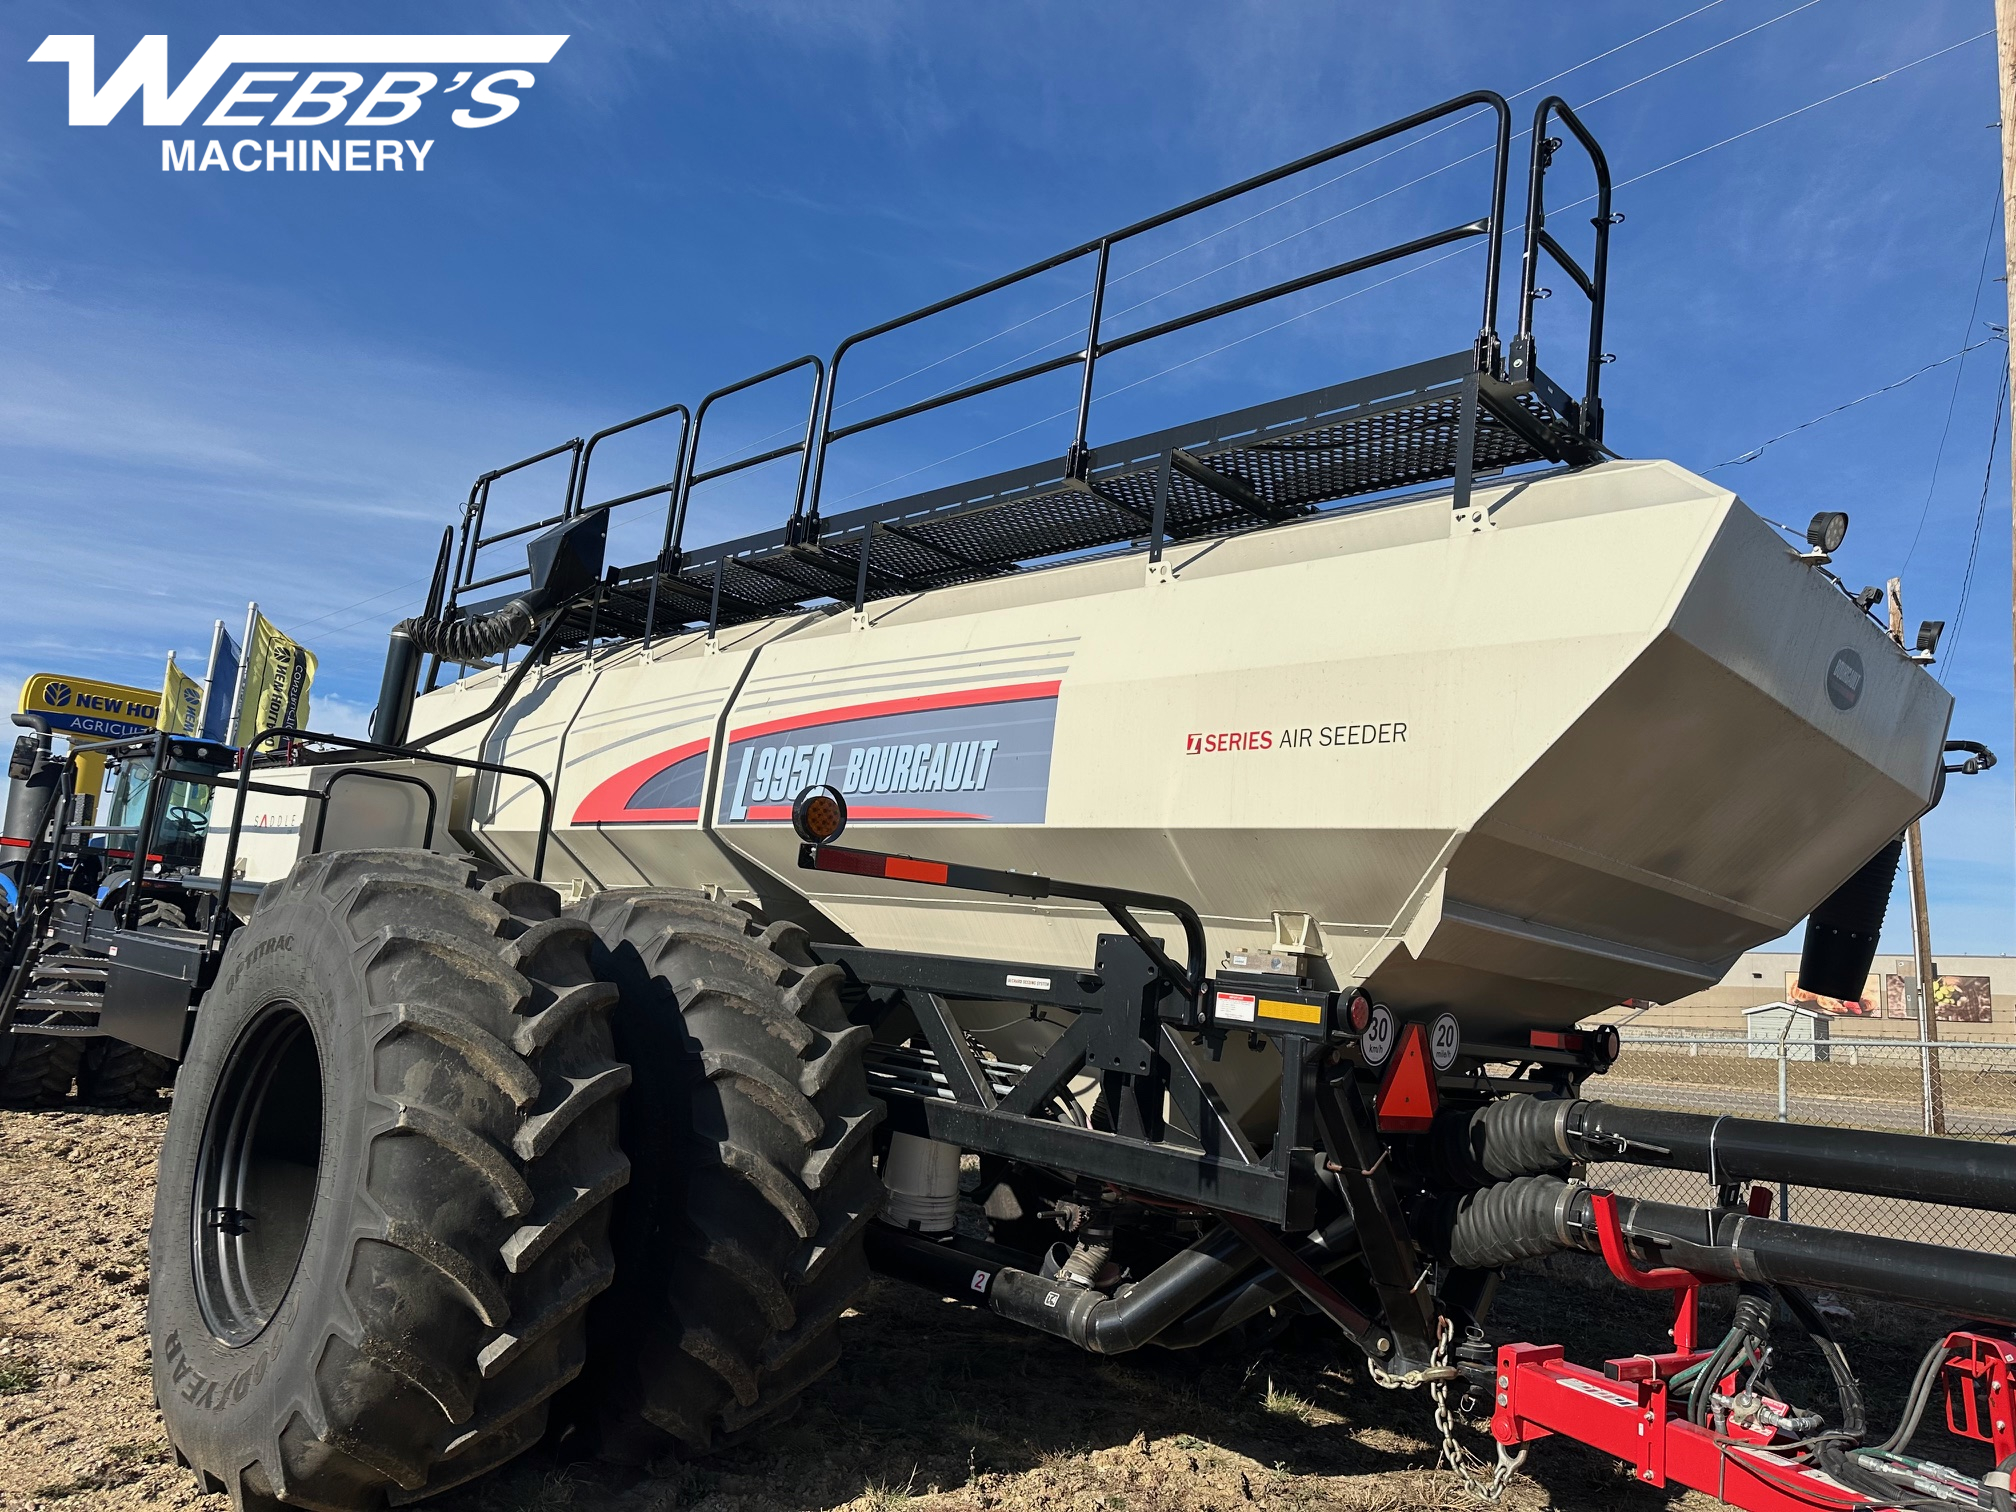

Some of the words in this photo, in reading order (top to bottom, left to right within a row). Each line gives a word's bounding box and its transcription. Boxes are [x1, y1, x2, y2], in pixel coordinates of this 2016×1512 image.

[76, 692, 123, 714] NEW
[1205, 731, 1272, 752] SERIES
[1279, 728, 1313, 749] AIR
[1319, 722, 1408, 747] SEEDER
[843, 740, 999, 794] BOURGAULT
[254, 814, 296, 827] SADDLE
[226, 935, 294, 995] OPTITRAC
[1368, 1017, 1388, 1041] 30
[1436, 1024, 1454, 1047] 20
[1369, 1044, 1383, 1054] km/h
[975, 1273, 986, 1290] 2
